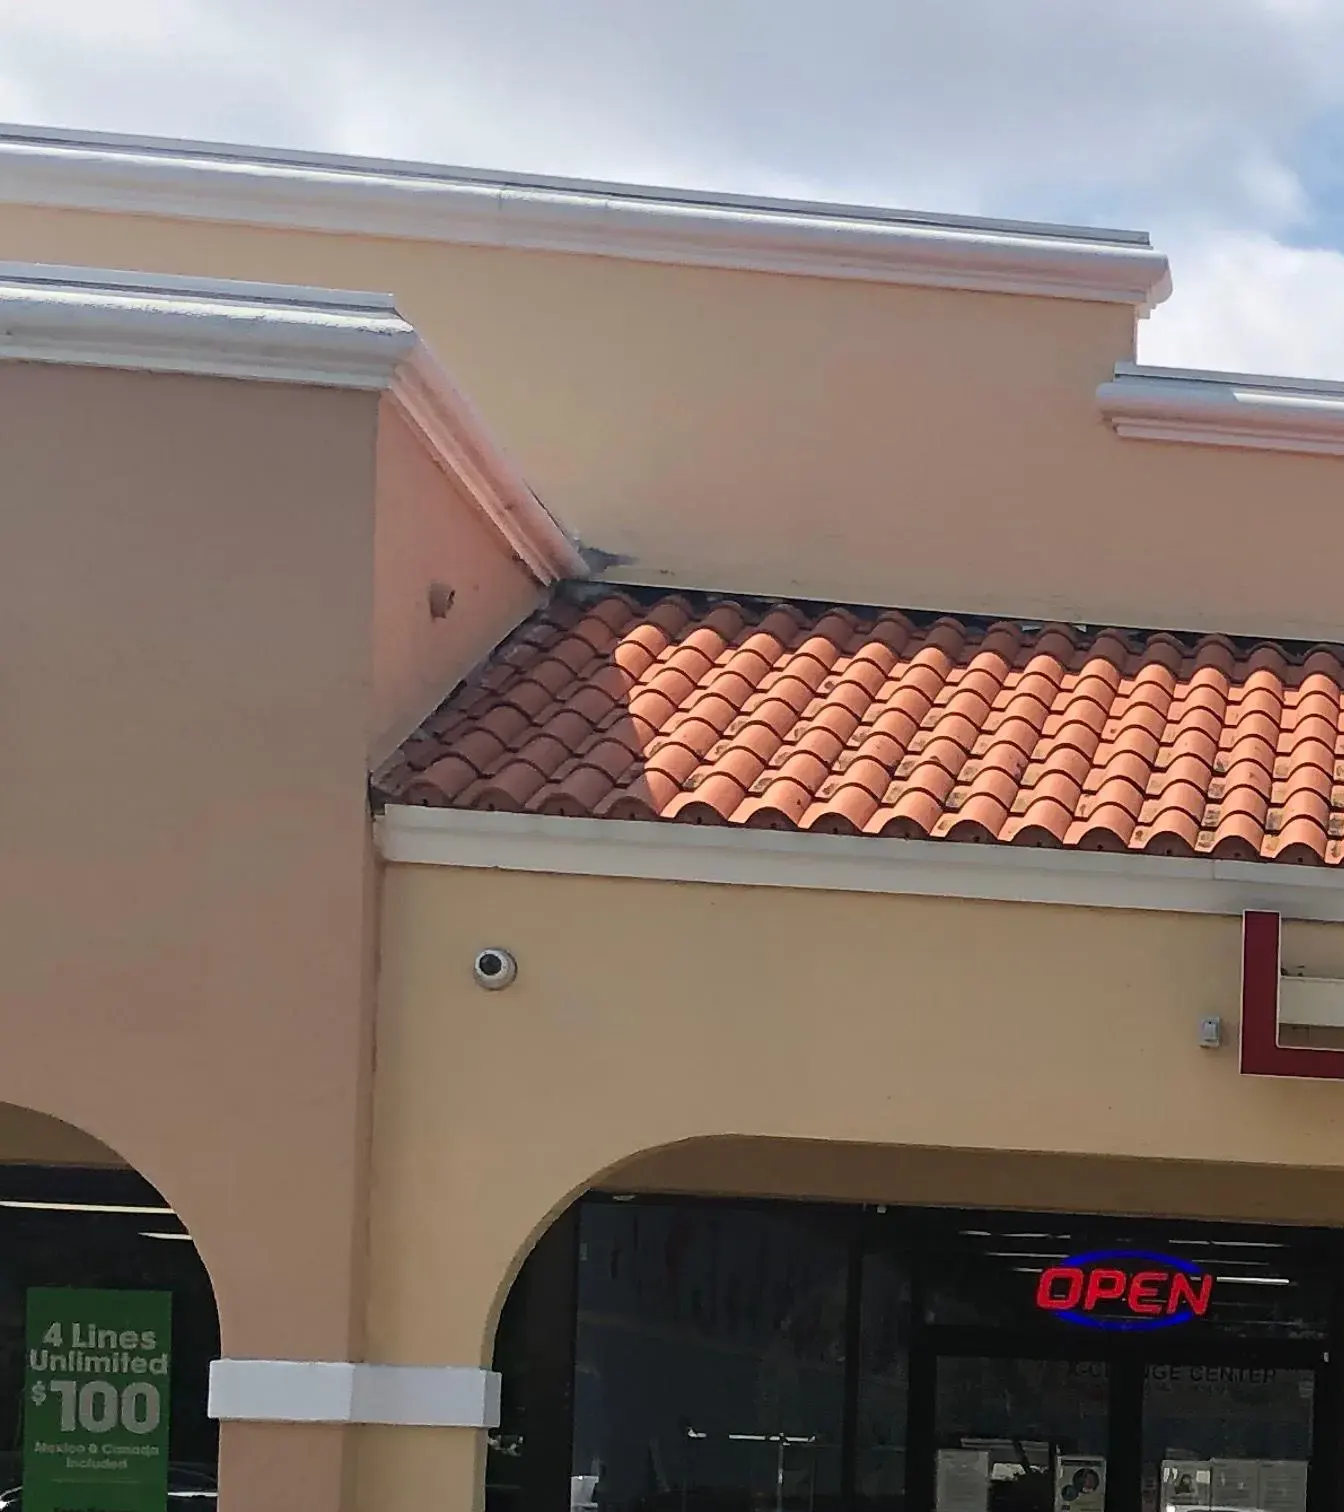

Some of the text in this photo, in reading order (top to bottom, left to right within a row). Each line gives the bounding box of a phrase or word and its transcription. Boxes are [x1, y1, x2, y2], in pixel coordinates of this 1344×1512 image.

[1036, 1267, 1213, 1316] OPEN
[41, 1319, 157, 1351] 4 Lines
[29, 1347, 169, 1375] Unlimited
[29, 1379, 161, 1434] $100
[66, 1457, 128, 1468] Included
